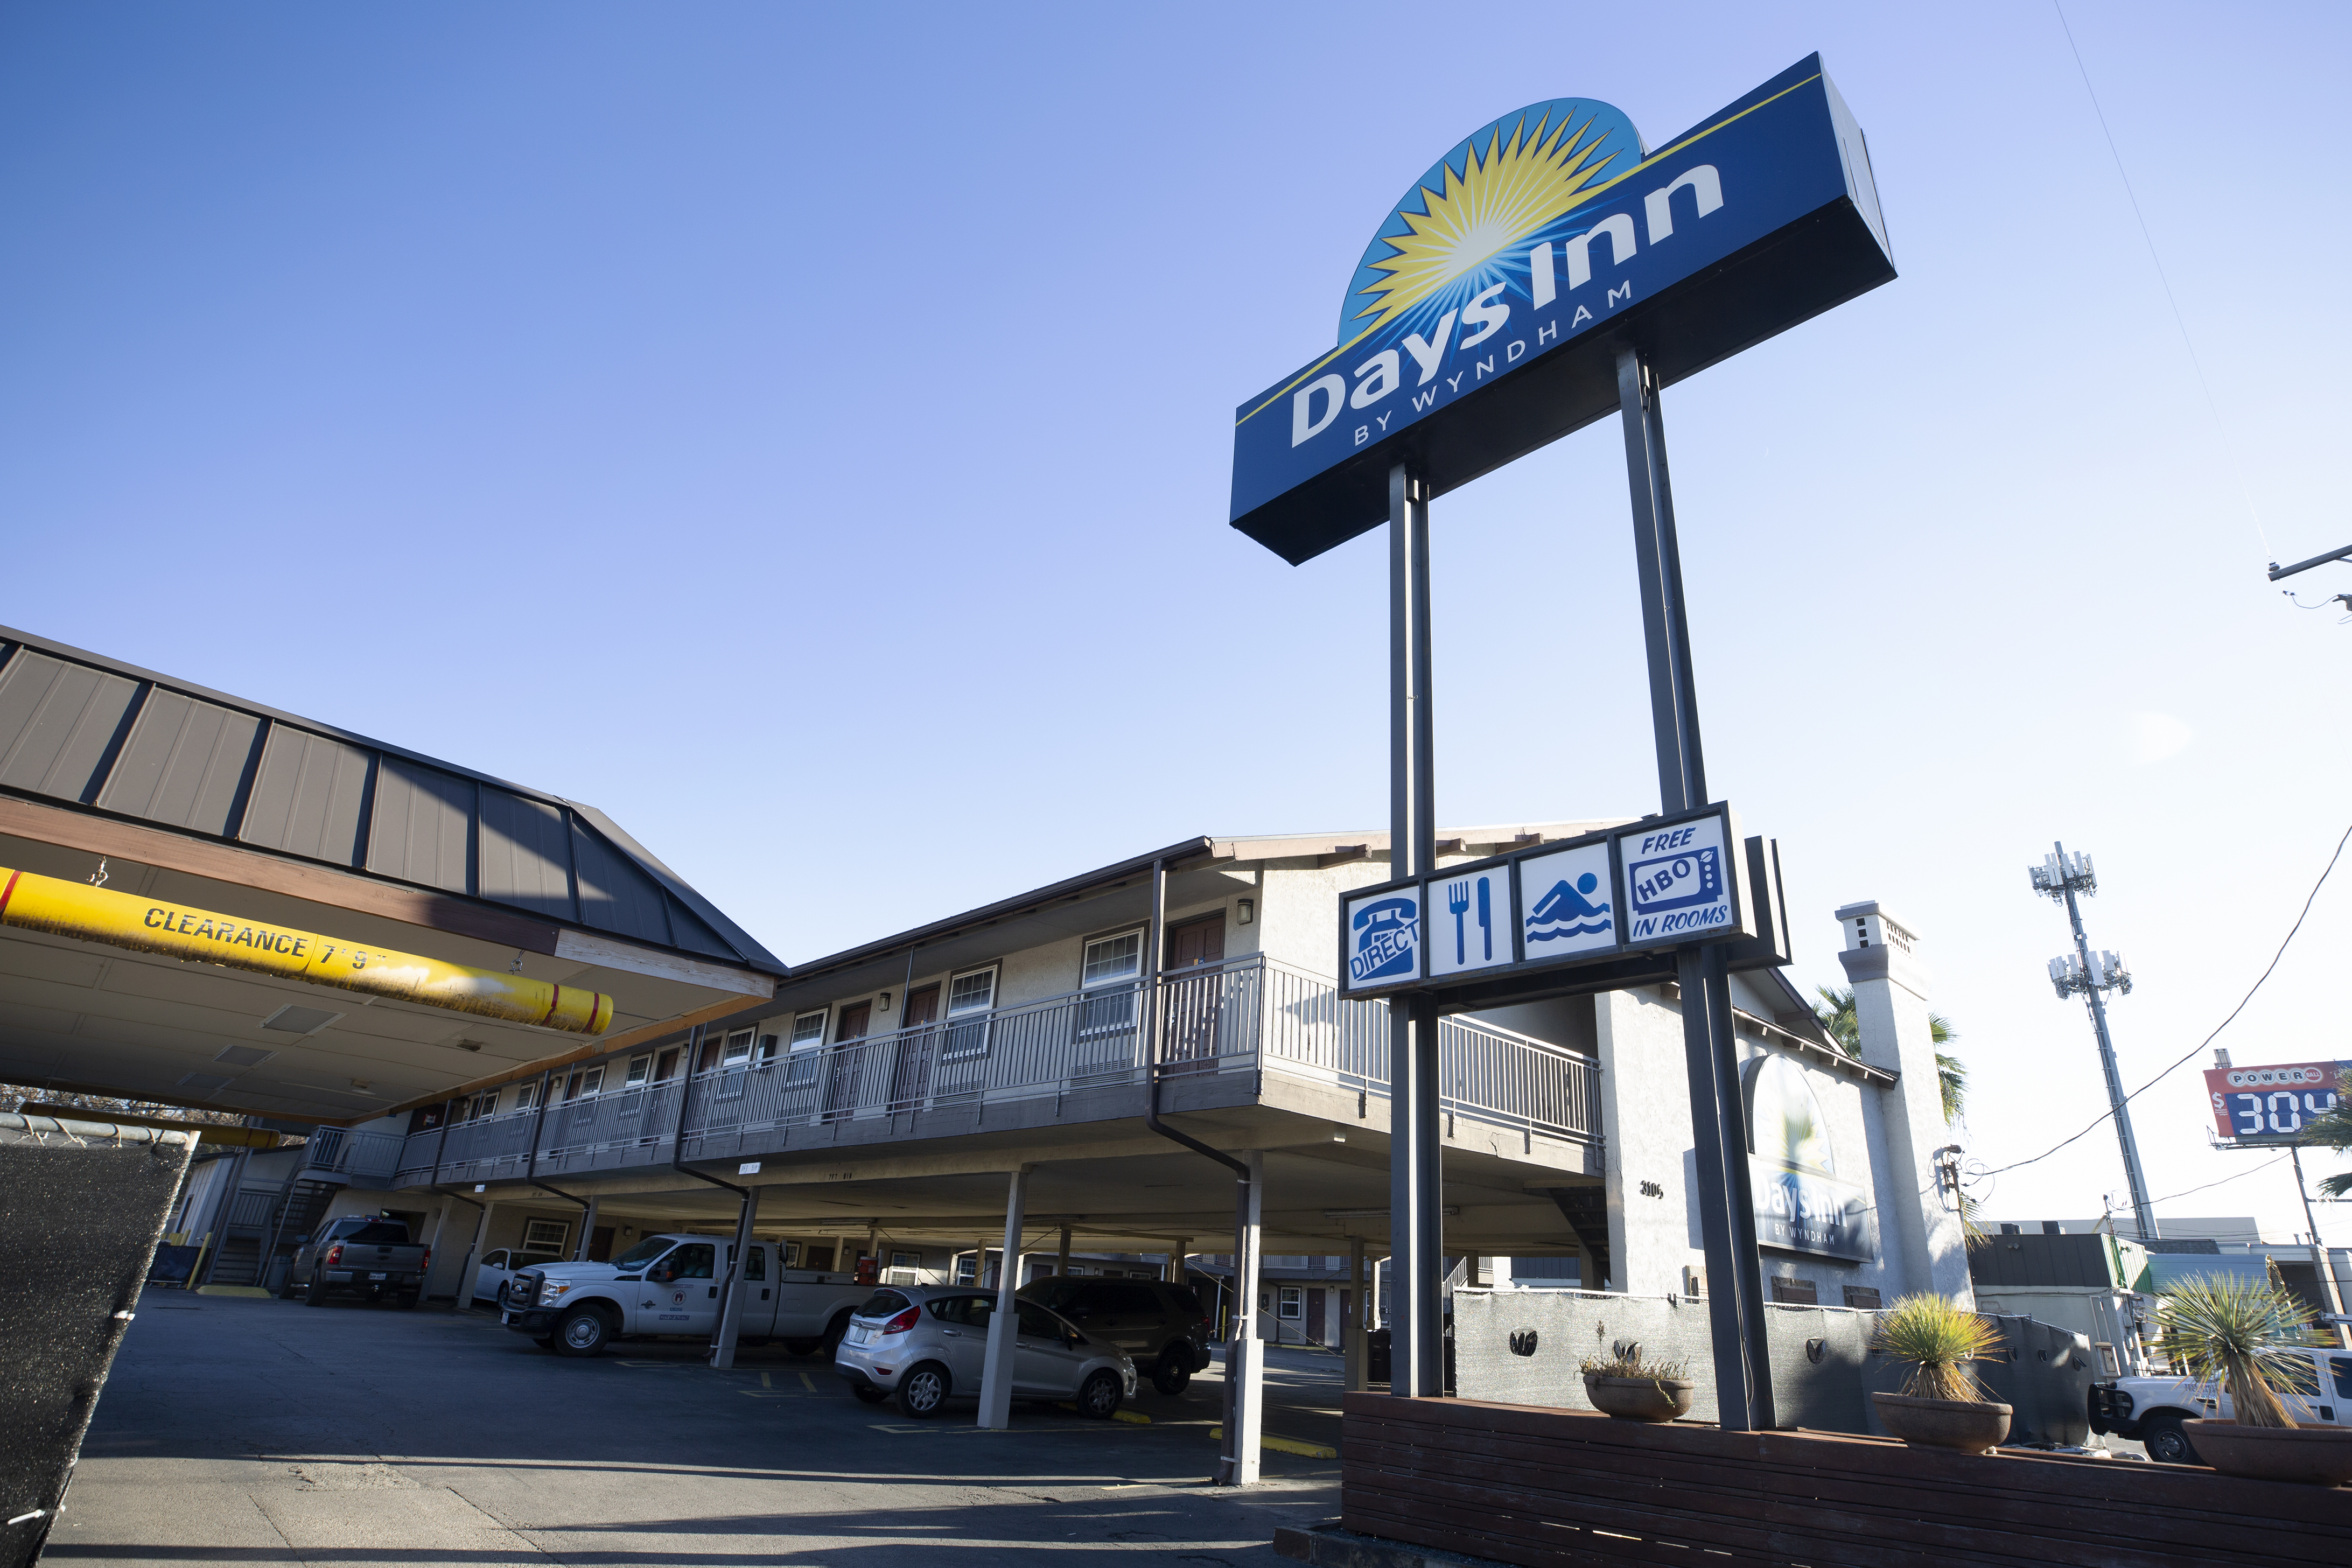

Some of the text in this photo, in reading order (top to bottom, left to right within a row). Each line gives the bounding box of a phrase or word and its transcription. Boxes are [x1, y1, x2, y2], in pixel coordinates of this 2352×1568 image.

[1291, 164, 1724, 449] Days Inn
[1354, 279, 1633, 447] BY WYNDHAM
[1641, 827, 1696, 855] FREE
[1636, 857, 1691, 903] HBO
[143, 907, 309, 958] CLEARANCE
[1633, 905, 1728, 937] IN ROOMS
[1349, 919, 1420, 981] DIRECT
[1751, 1170, 1847, 1228] Days Inn
[1775, 1223, 1835, 1245] BY WYNDHAM
